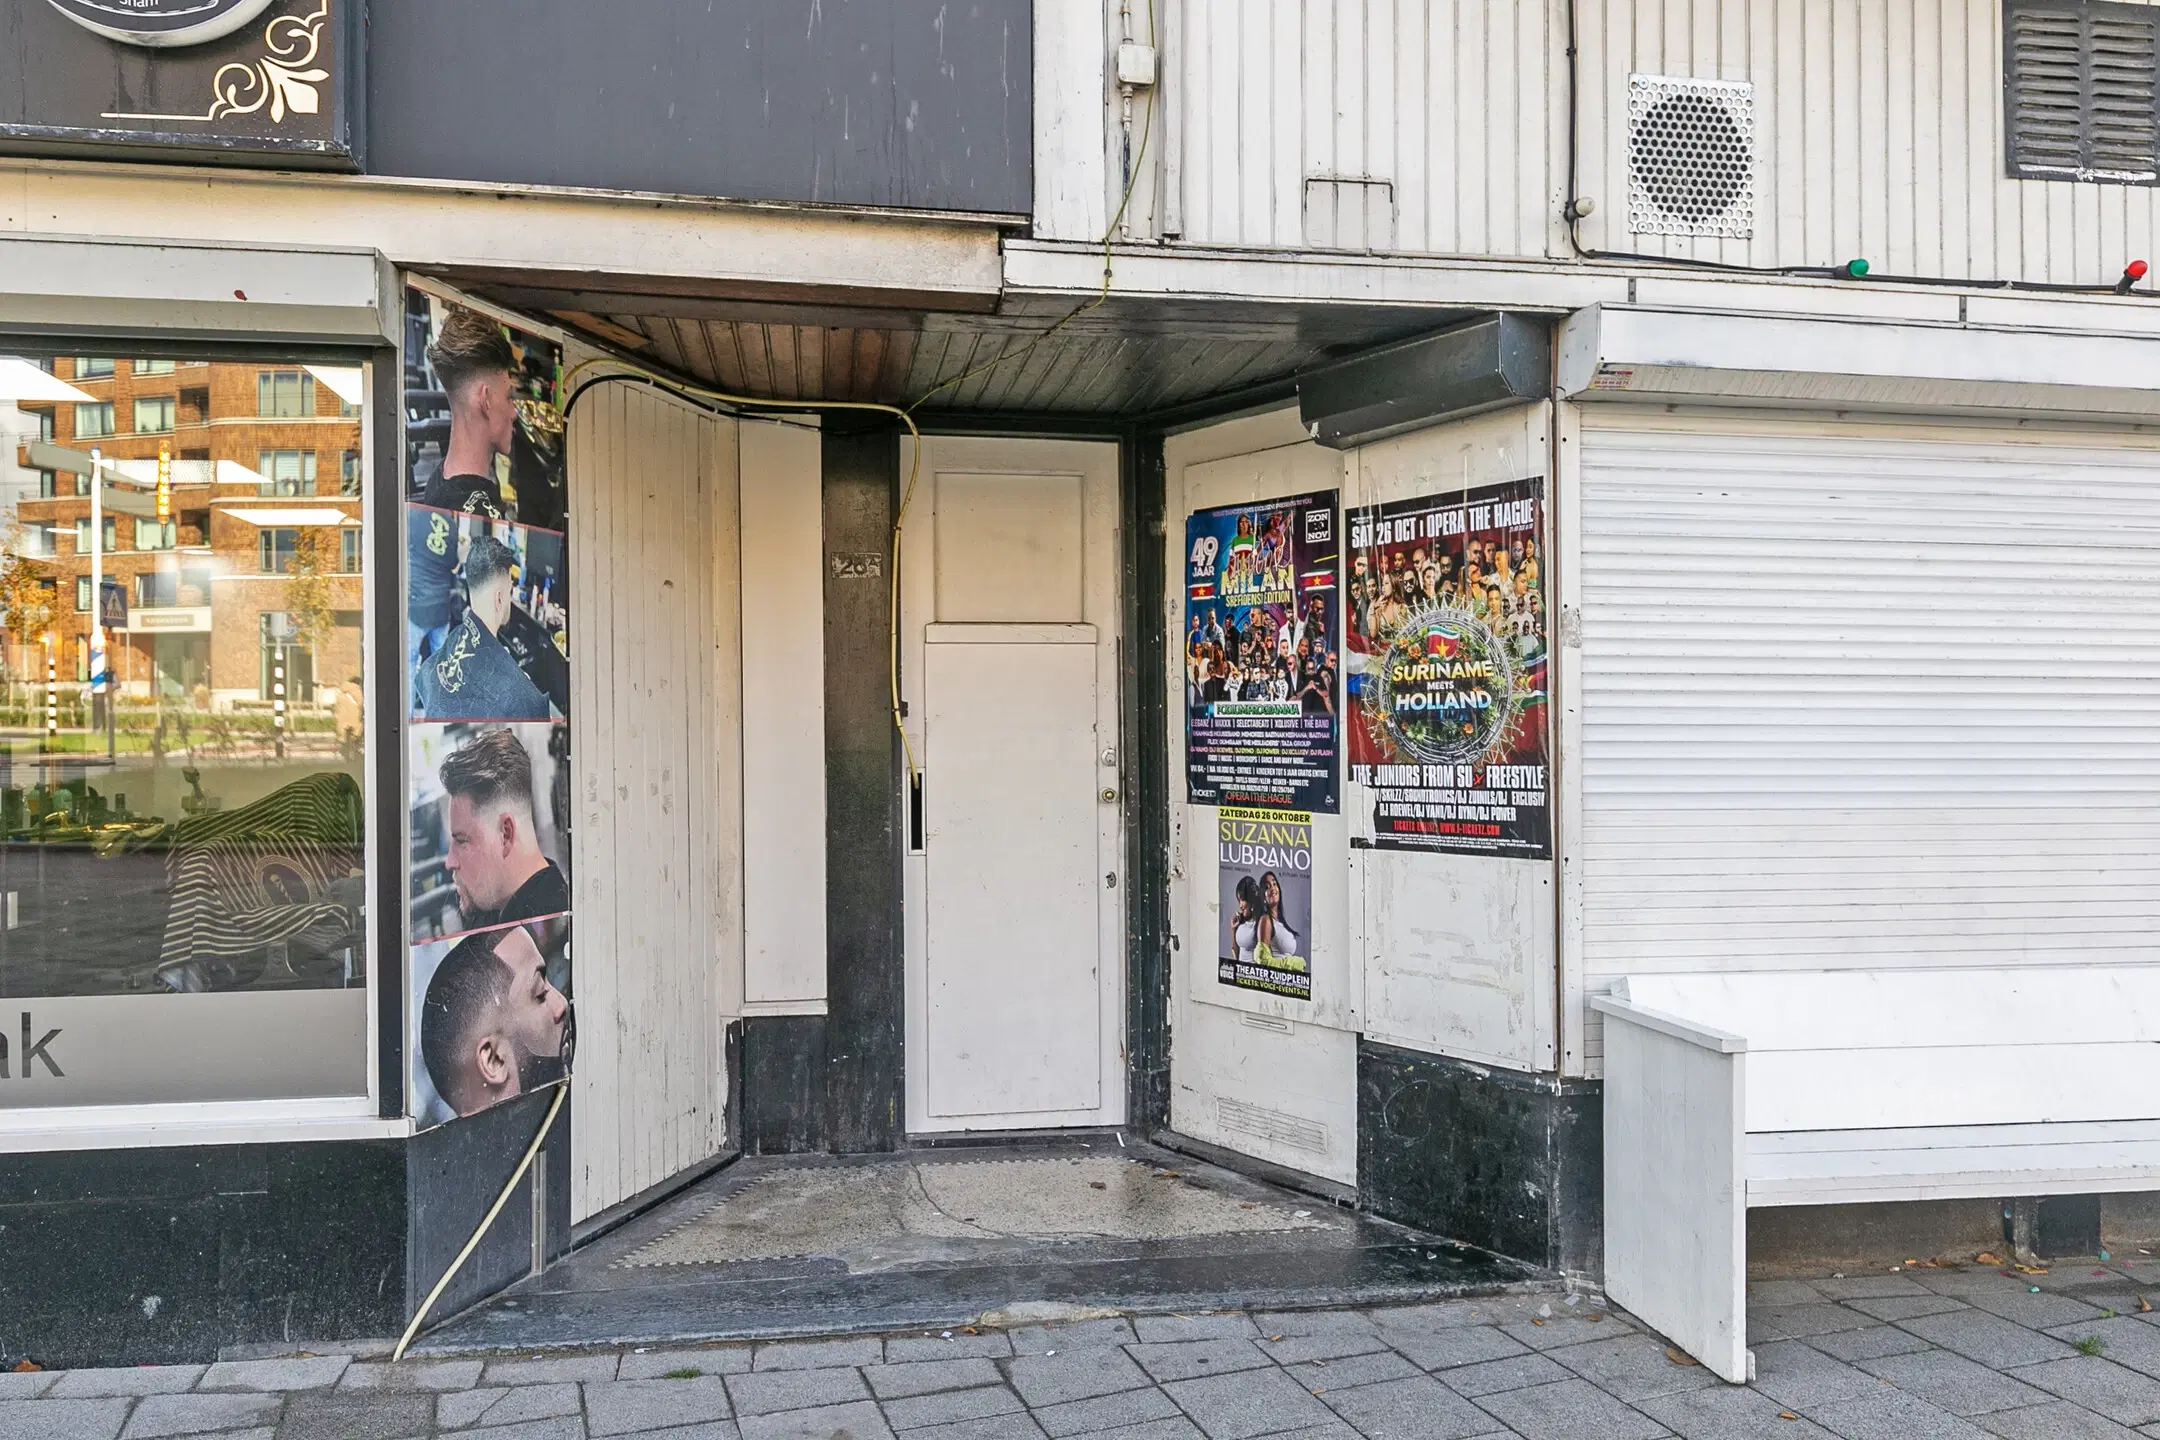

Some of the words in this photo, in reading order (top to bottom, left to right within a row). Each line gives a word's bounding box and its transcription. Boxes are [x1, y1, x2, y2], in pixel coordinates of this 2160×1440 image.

[1308, 512, 1328, 523] ZON
[1351, 523, 1374, 549] SAT
[1376, 520, 1392, 546] 26
[1394, 517, 1417, 543] OCT
[1426, 509, 1466, 538] OPERA
[1468, 505, 1491, 532] THE
[1493, 498, 1534, 528] HAGUE
[1308, 530, 1329, 540] NOV
[1190, 536, 1219, 569] 49
[1193, 565, 1215, 577] JAAR
[1220, 564, 1294, 596] MILAN
[1264, 590, 1290, 605] EDITION
[1392, 659, 1495, 683] SURINAME
[1426, 680, 1455, 691] MEETS
[1394, 690, 1493, 712] HOLLAND
[1236, 719, 1269, 728] SELECTABEATS
[1304, 719, 1315, 729] THE
[1315, 719, 1330, 729] BAND
[1256, 768, 1275, 776] KINDEREN
[1298, 769, 1312, 777] GRATIS
[1312, 770, 1329, 778] ENTREE
[1352, 764, 1372, 786] THE
[1374, 764, 1421, 788] JUNIORS
[1422, 765, 1455, 788] FROM
[1456, 764, 1474, 789] SU
[1485, 765, 1545, 790] FREESTYLE
[1225, 790, 1250, 801] OPERA
[1252, 792, 1268, 803] THE
[1267, 793, 1293, 804] HAGUE
[1511, 791, 1546, 807] EXCLUSIV
[1220, 808, 1261, 819] ZATERDAG
[1261, 811, 1271, 820] 26
[1272, 812, 1311, 823] OKTOBER
[1379, 803, 1389, 817] DJ
[1389, 803, 1425, 819] ROEWEL/DJ
[1458, 805, 1490, 821] DYNO/DJ
[1490, 807, 1517, 822] POWER
[1220, 821, 1310, 848] SUZANNA
[1220, 842, 1311, 870] LUBRANO
[1235, 963, 1269, 979] THEATER
[1269, 970, 1310, 986] ZUIDPLEIN
[1235, 976, 1260, 987] TICKETS:
[1260, 980, 1310, 997] VOICE-EVENTS.NL
[0, 1011, 66, 1079] k
